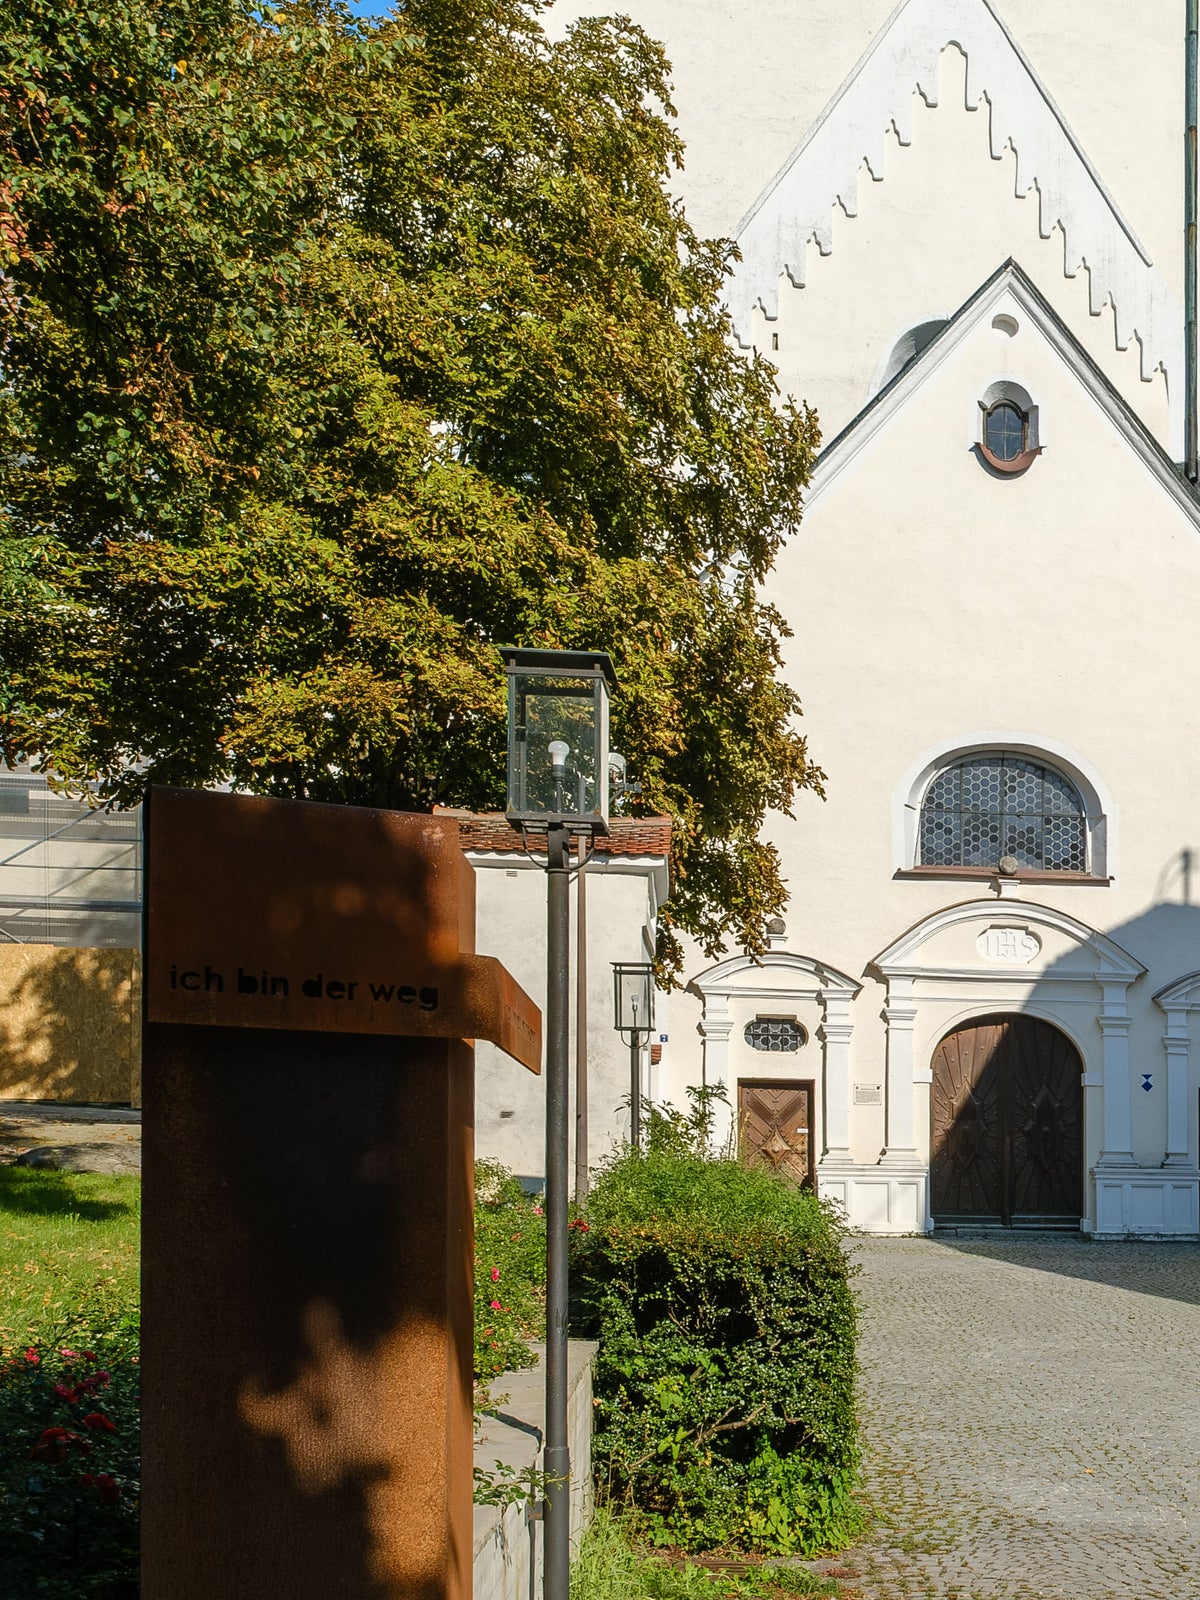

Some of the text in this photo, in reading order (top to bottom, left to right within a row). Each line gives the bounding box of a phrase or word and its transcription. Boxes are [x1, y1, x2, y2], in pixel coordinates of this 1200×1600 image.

[169, 964, 440, 1011] ich bin der weg
